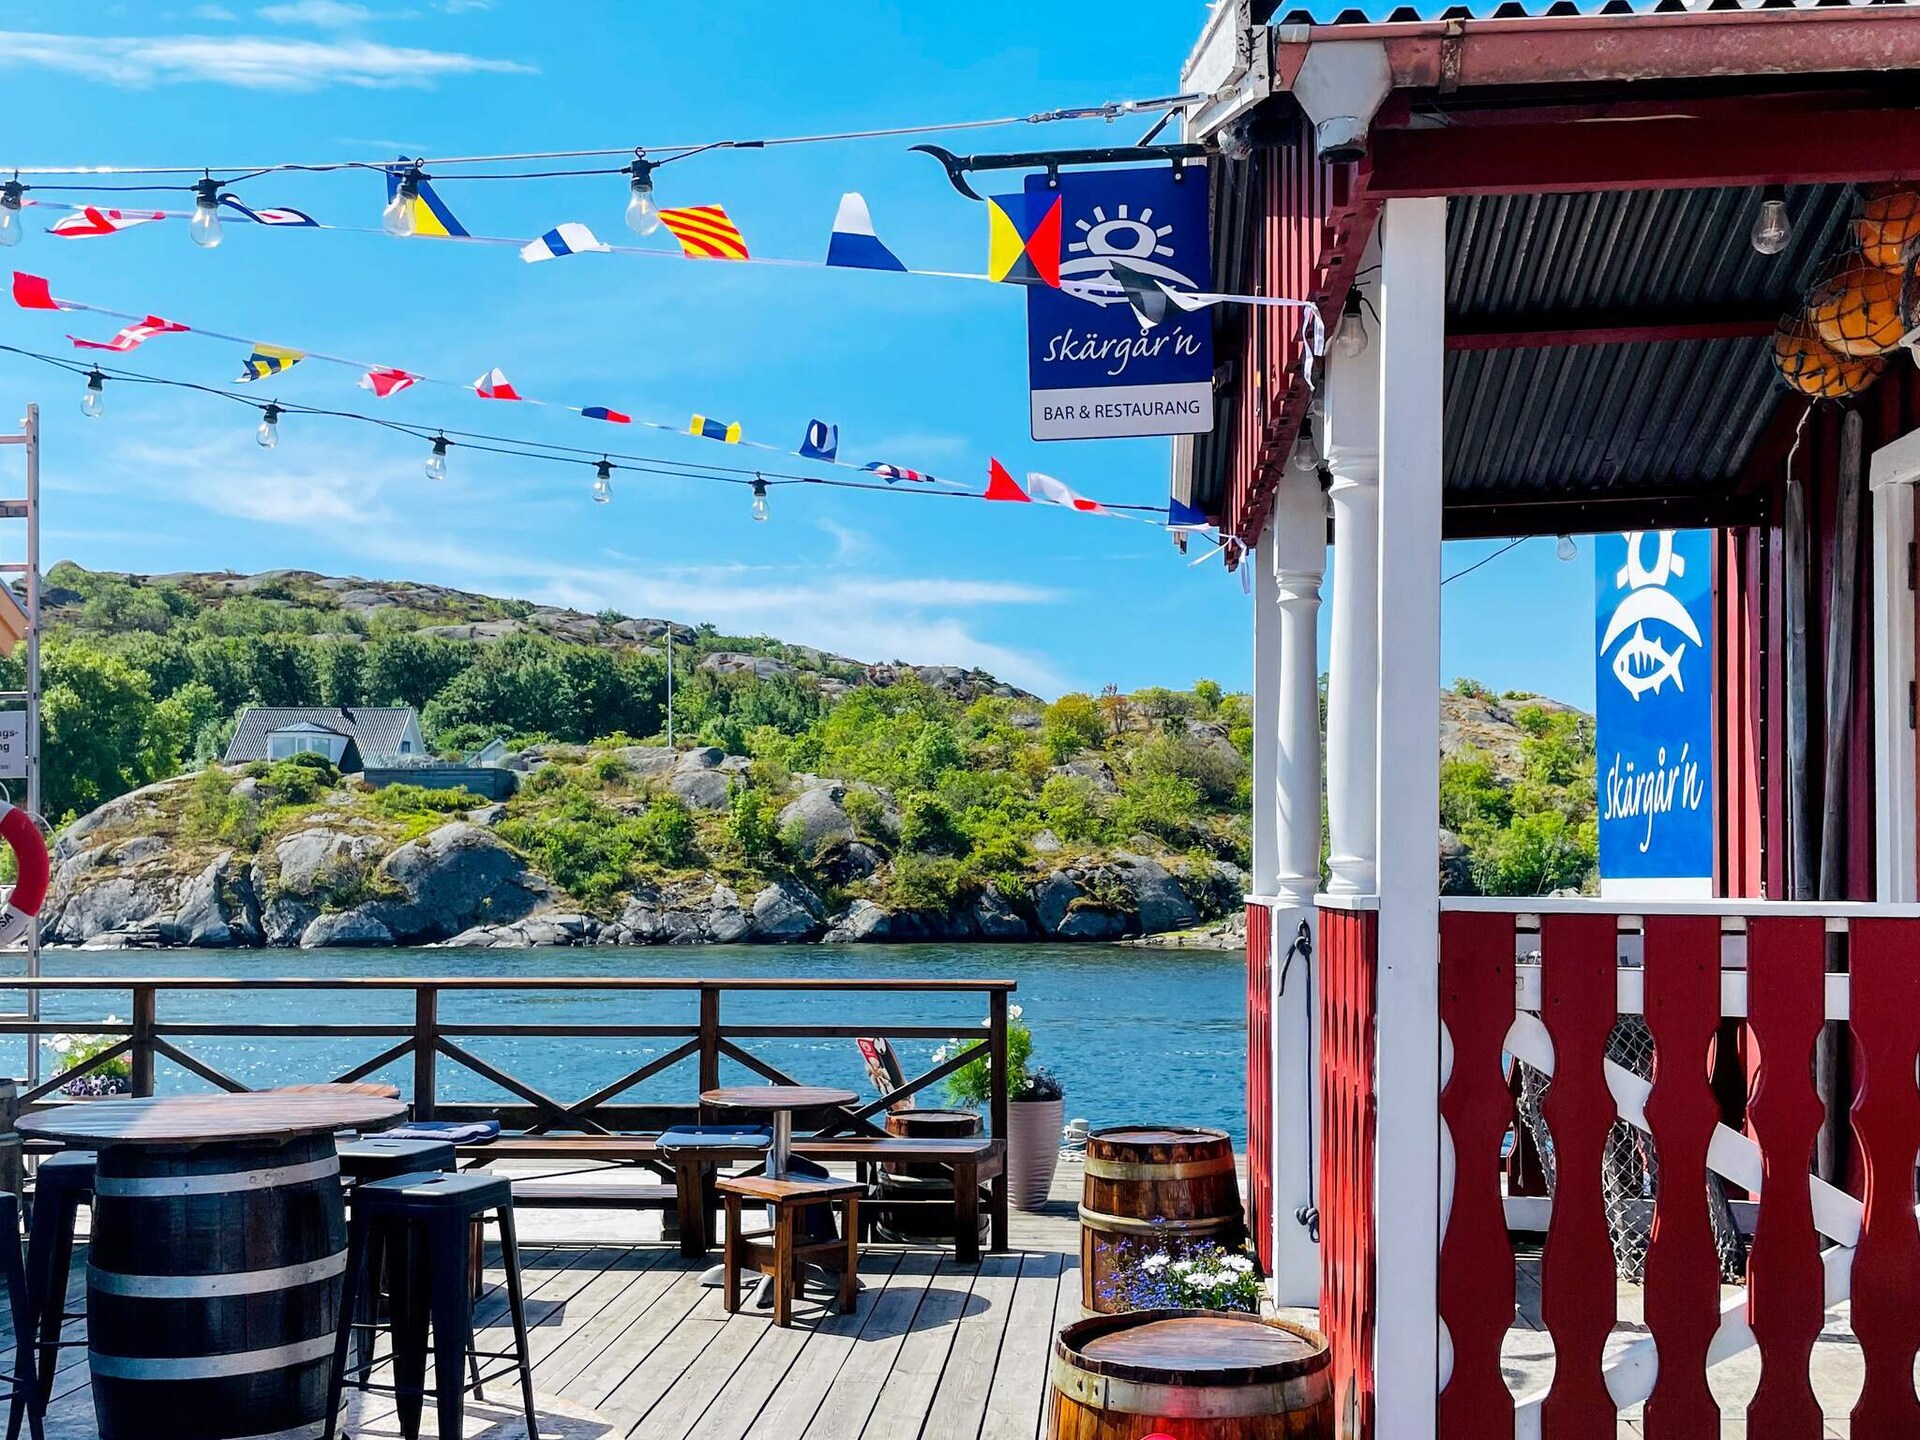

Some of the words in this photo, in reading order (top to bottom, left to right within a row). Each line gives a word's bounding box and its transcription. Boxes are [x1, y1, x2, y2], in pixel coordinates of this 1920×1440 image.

[1044, 406, 1074, 420] BAR
[1079, 405, 1090, 419] &
[1095, 400, 1200, 418] RESTAURANG
